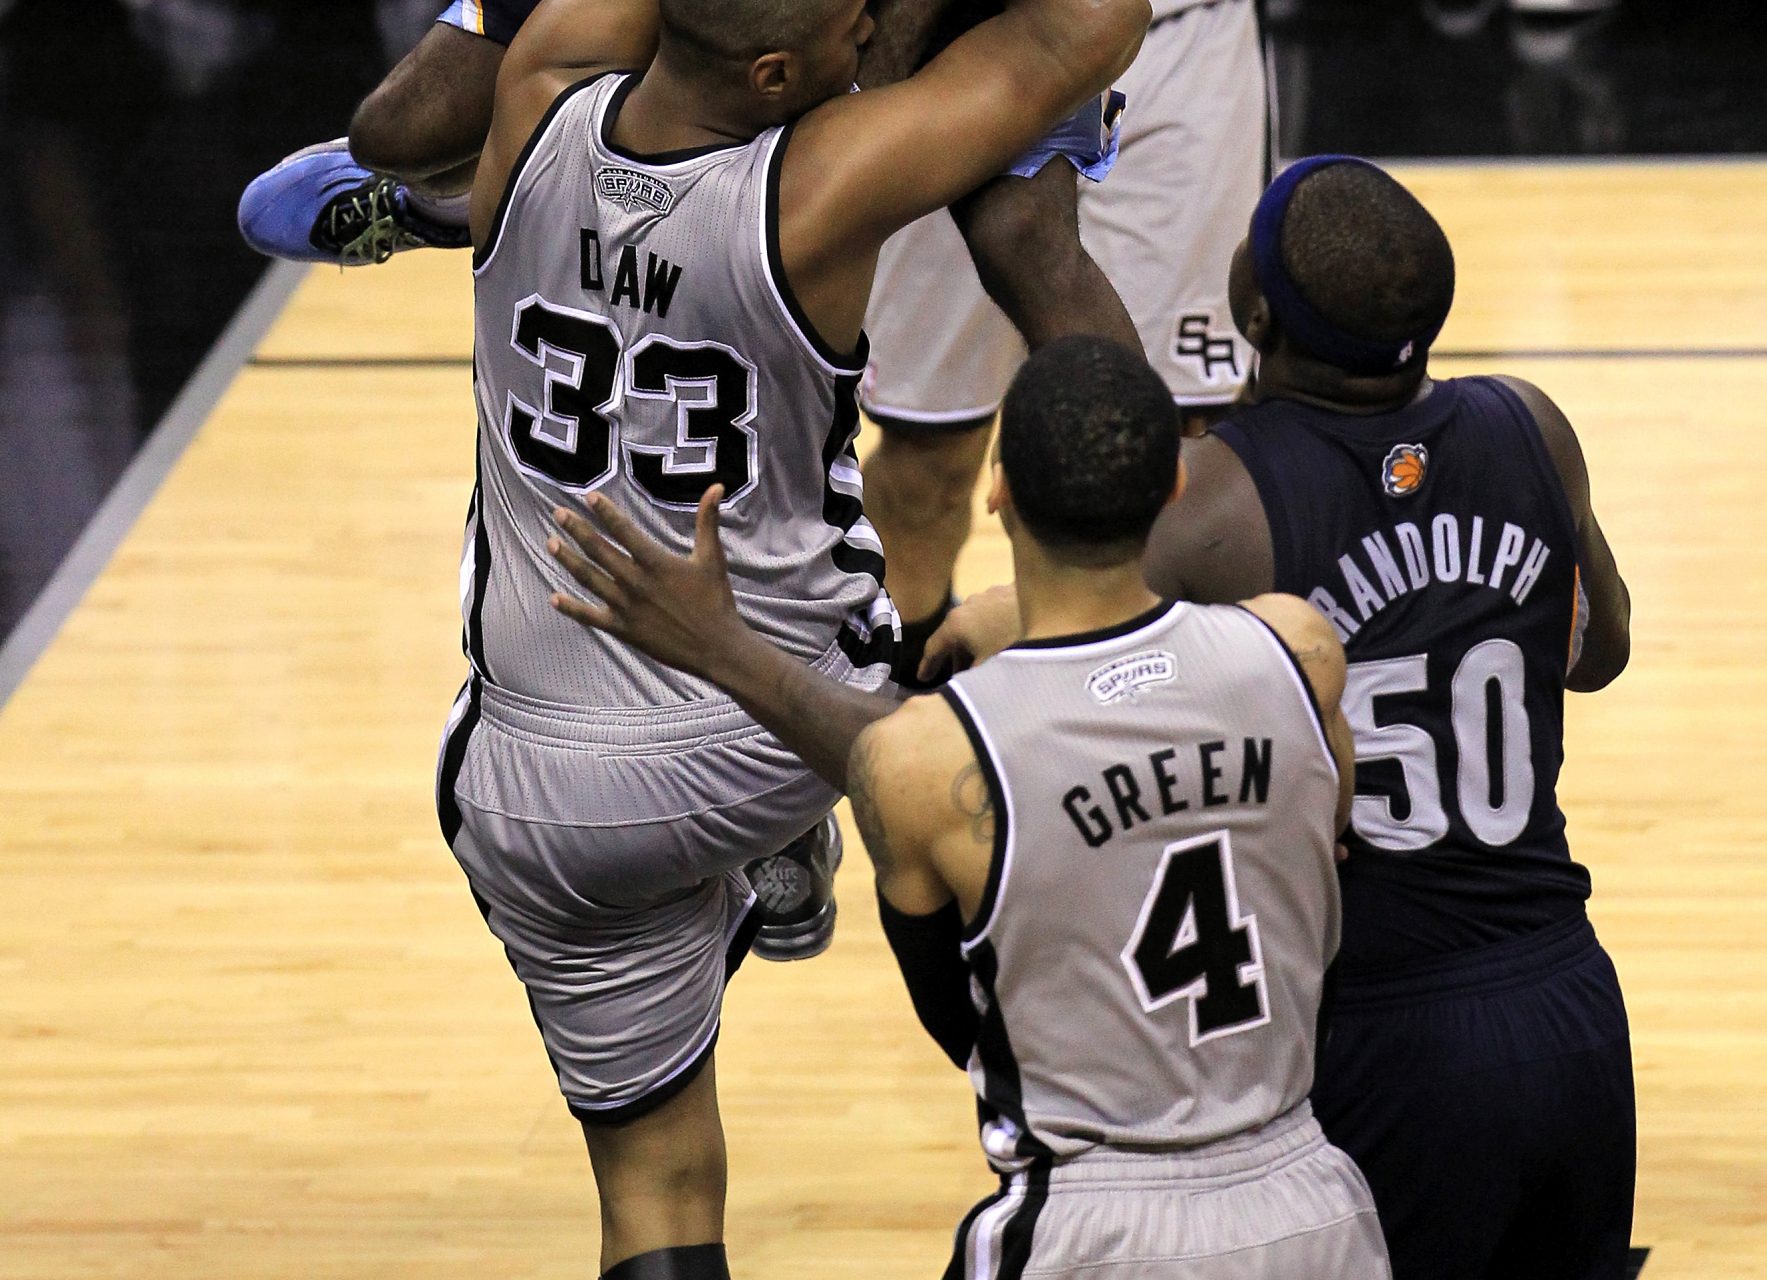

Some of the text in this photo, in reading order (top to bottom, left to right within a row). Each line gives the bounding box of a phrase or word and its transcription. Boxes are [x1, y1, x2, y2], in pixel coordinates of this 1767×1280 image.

[603, 177, 665, 206] SPURS
[503, 291, 759, 513] 33
[1306, 512, 1550, 644] RANDOLPH
[1096, 662, 1167, 694] SPURS
[1341, 637, 1535, 851] 50
[1061, 736, 1273, 848] GREEN
[1119, 828, 1272, 1048] 4
